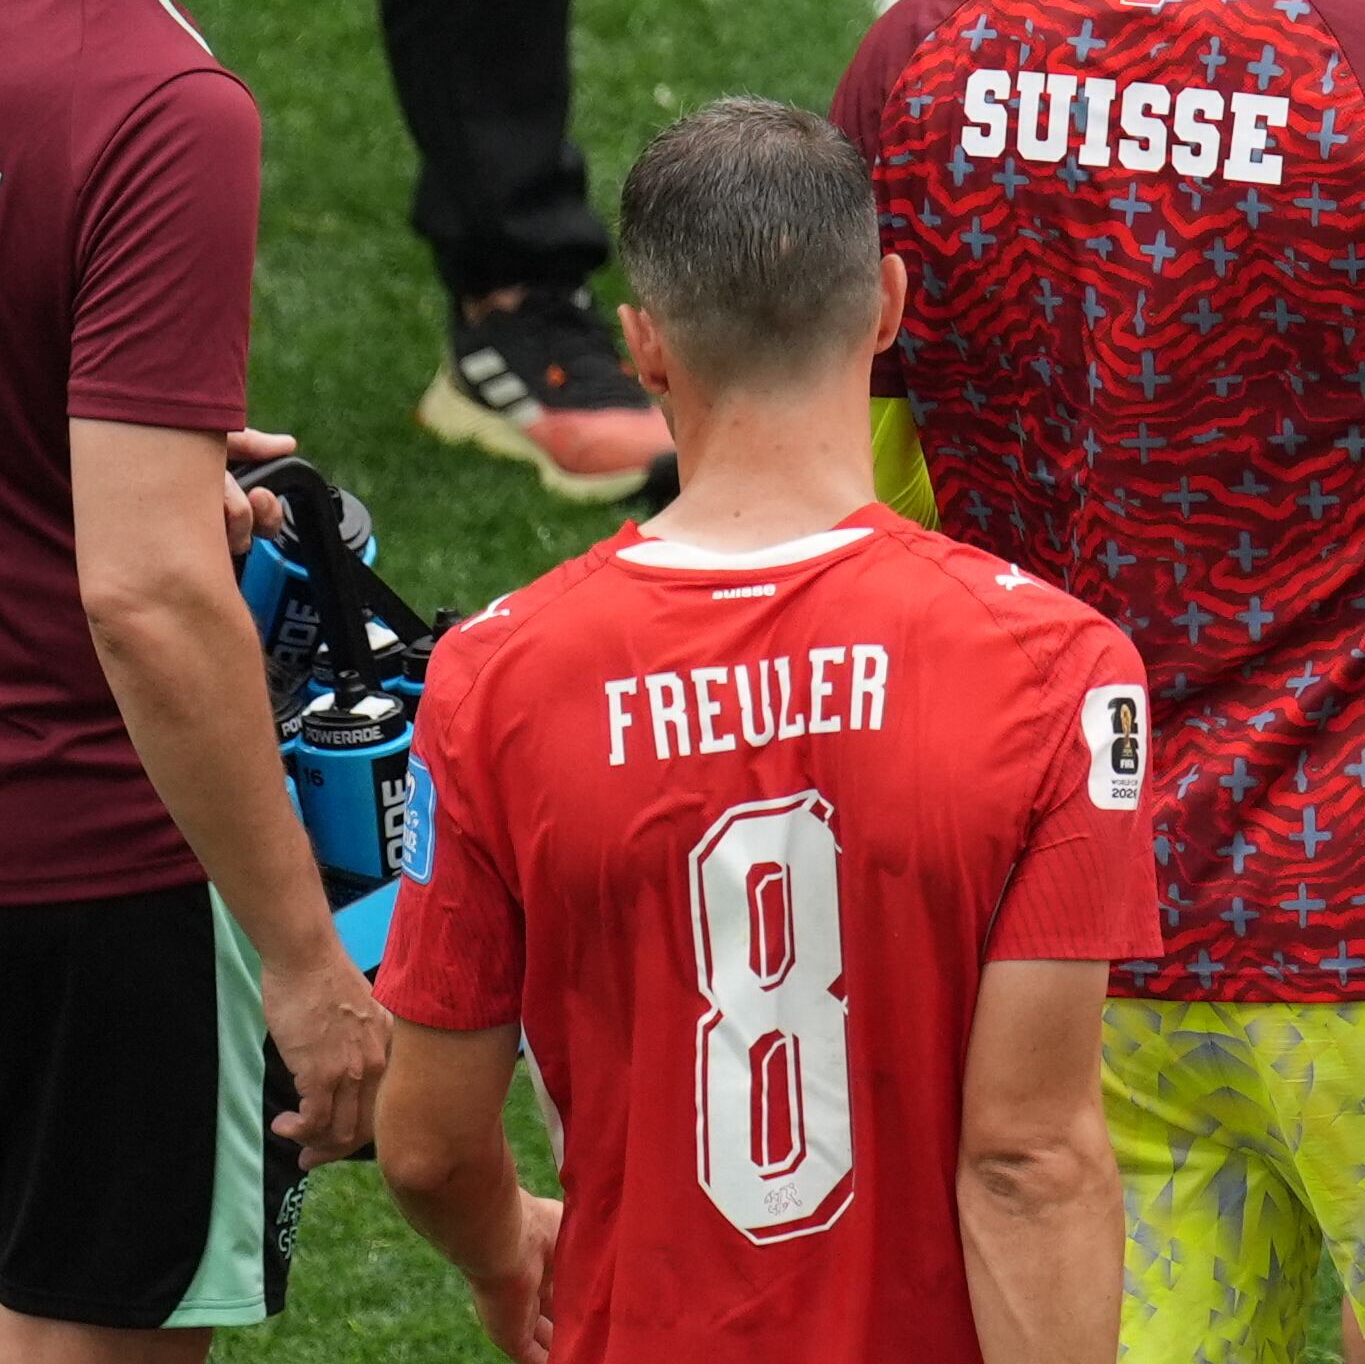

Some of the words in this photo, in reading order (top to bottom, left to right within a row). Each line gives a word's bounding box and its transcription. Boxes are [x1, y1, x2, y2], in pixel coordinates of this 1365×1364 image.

[960, 68, 1290, 186] SUISSE
[604, 643, 889, 766] FREULER
[303, 768, 325, 787] 16
[688, 789, 855, 1246] 8
